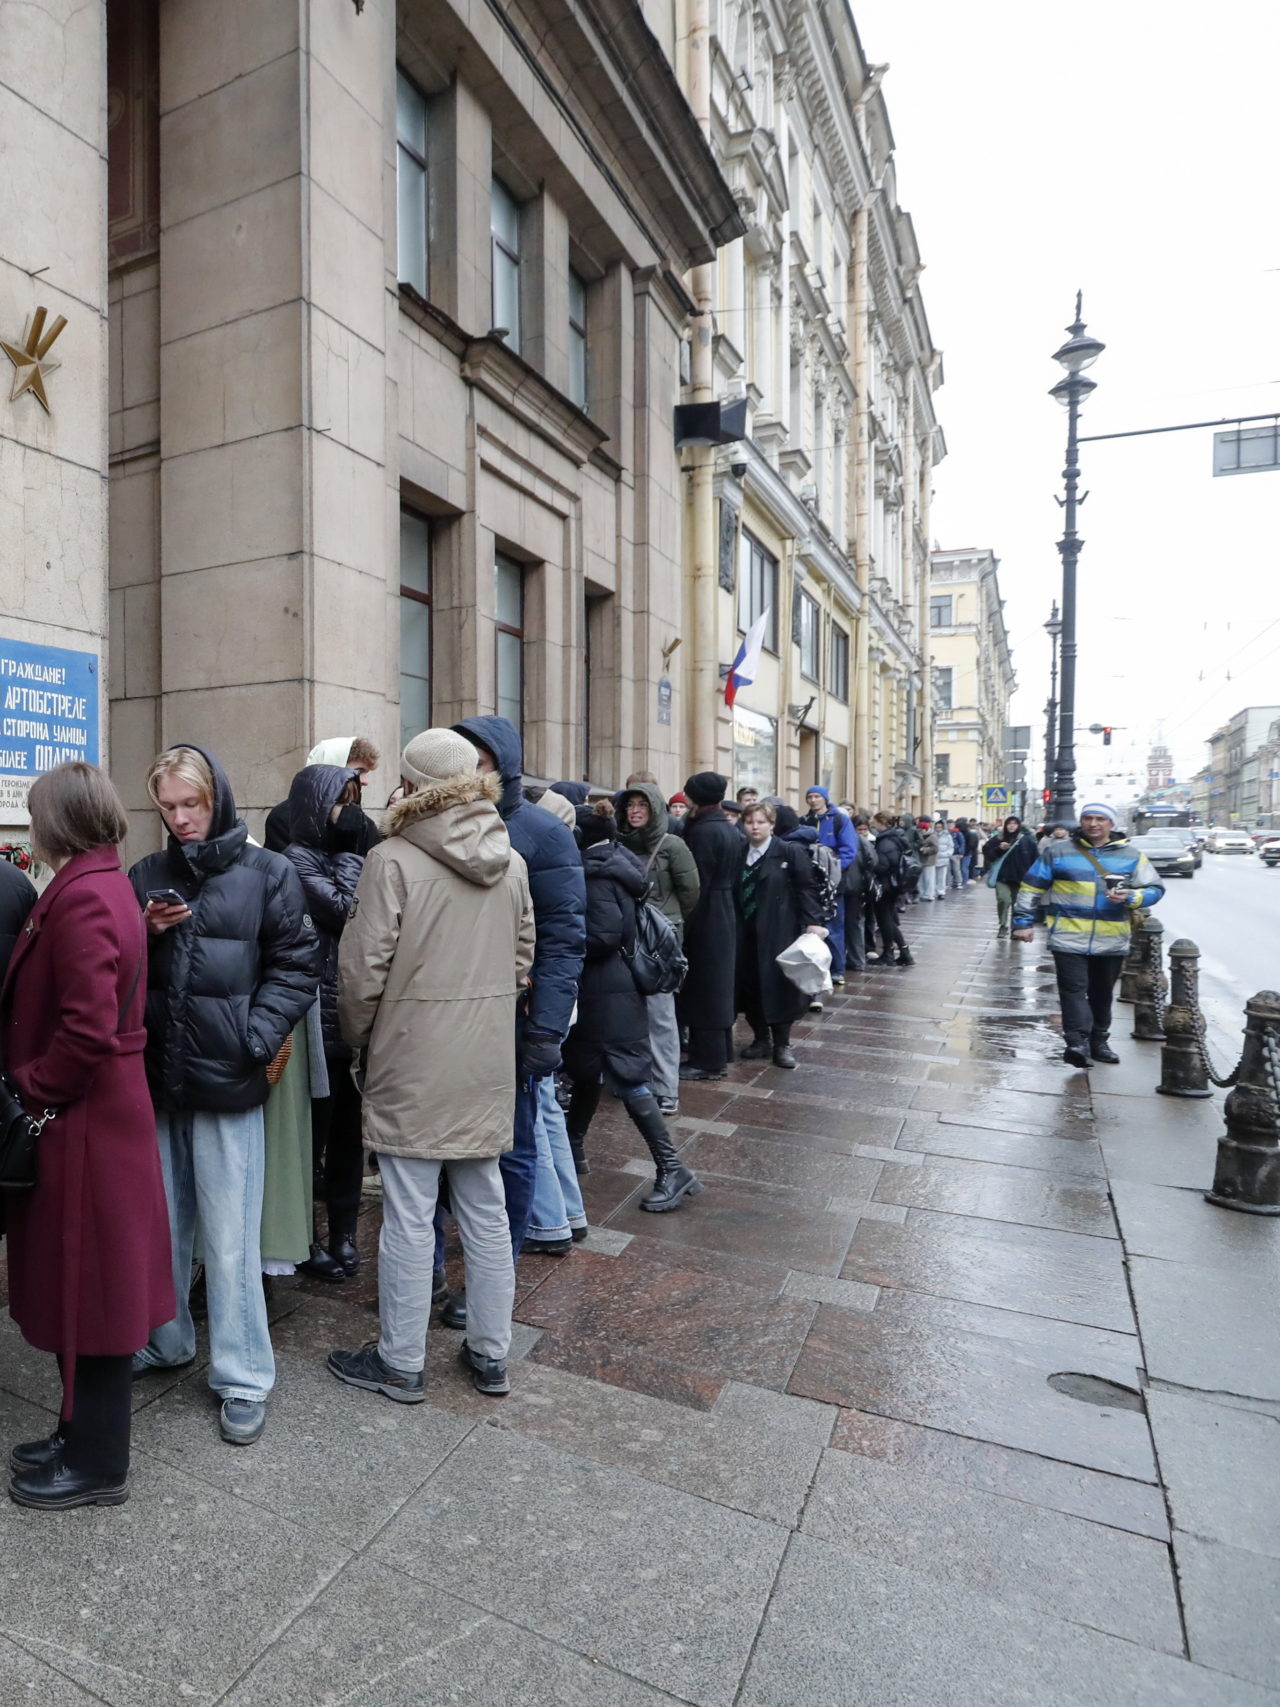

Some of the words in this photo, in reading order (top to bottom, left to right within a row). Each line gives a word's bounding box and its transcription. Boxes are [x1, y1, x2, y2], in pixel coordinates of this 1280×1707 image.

[1, 658, 66, 685] ГРАЖДАНЕ!
[4, 685, 87, 721] АРТОБСТРЕЛЕ
[3, 718, 50, 741] СТОРОНА
[53, 724, 88, 746] УЛИЦЫ
